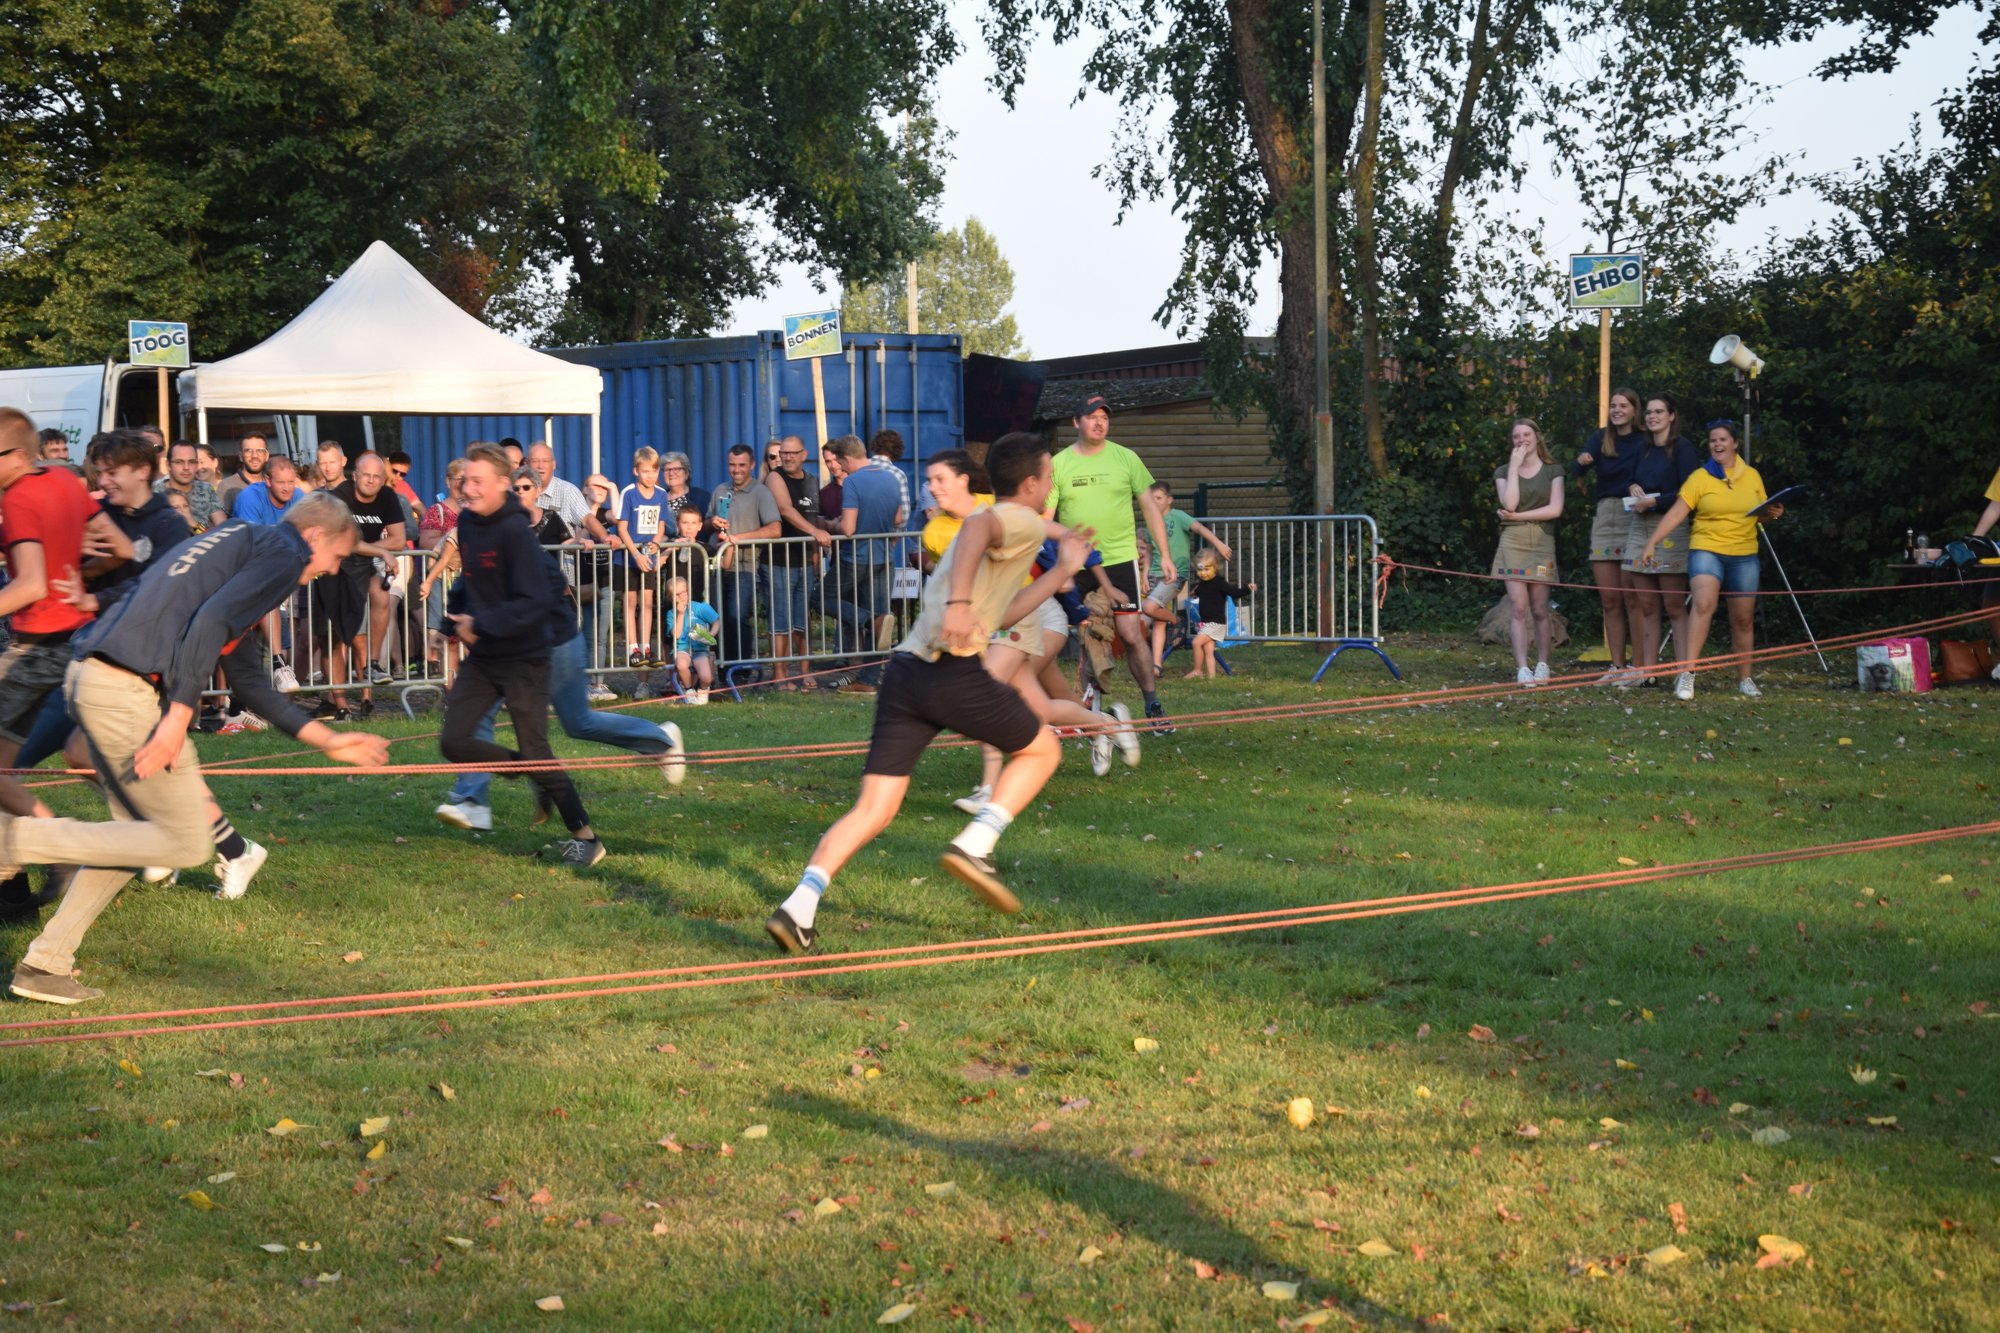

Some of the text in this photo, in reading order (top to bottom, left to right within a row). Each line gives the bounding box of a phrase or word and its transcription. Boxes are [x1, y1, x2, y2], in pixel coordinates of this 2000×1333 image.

[1573, 262, 1640, 297] EHBO
[131, 331, 186, 354] TOOG
[786, 320, 838, 347] BONNEN
[641, 509, 658, 525] 198
